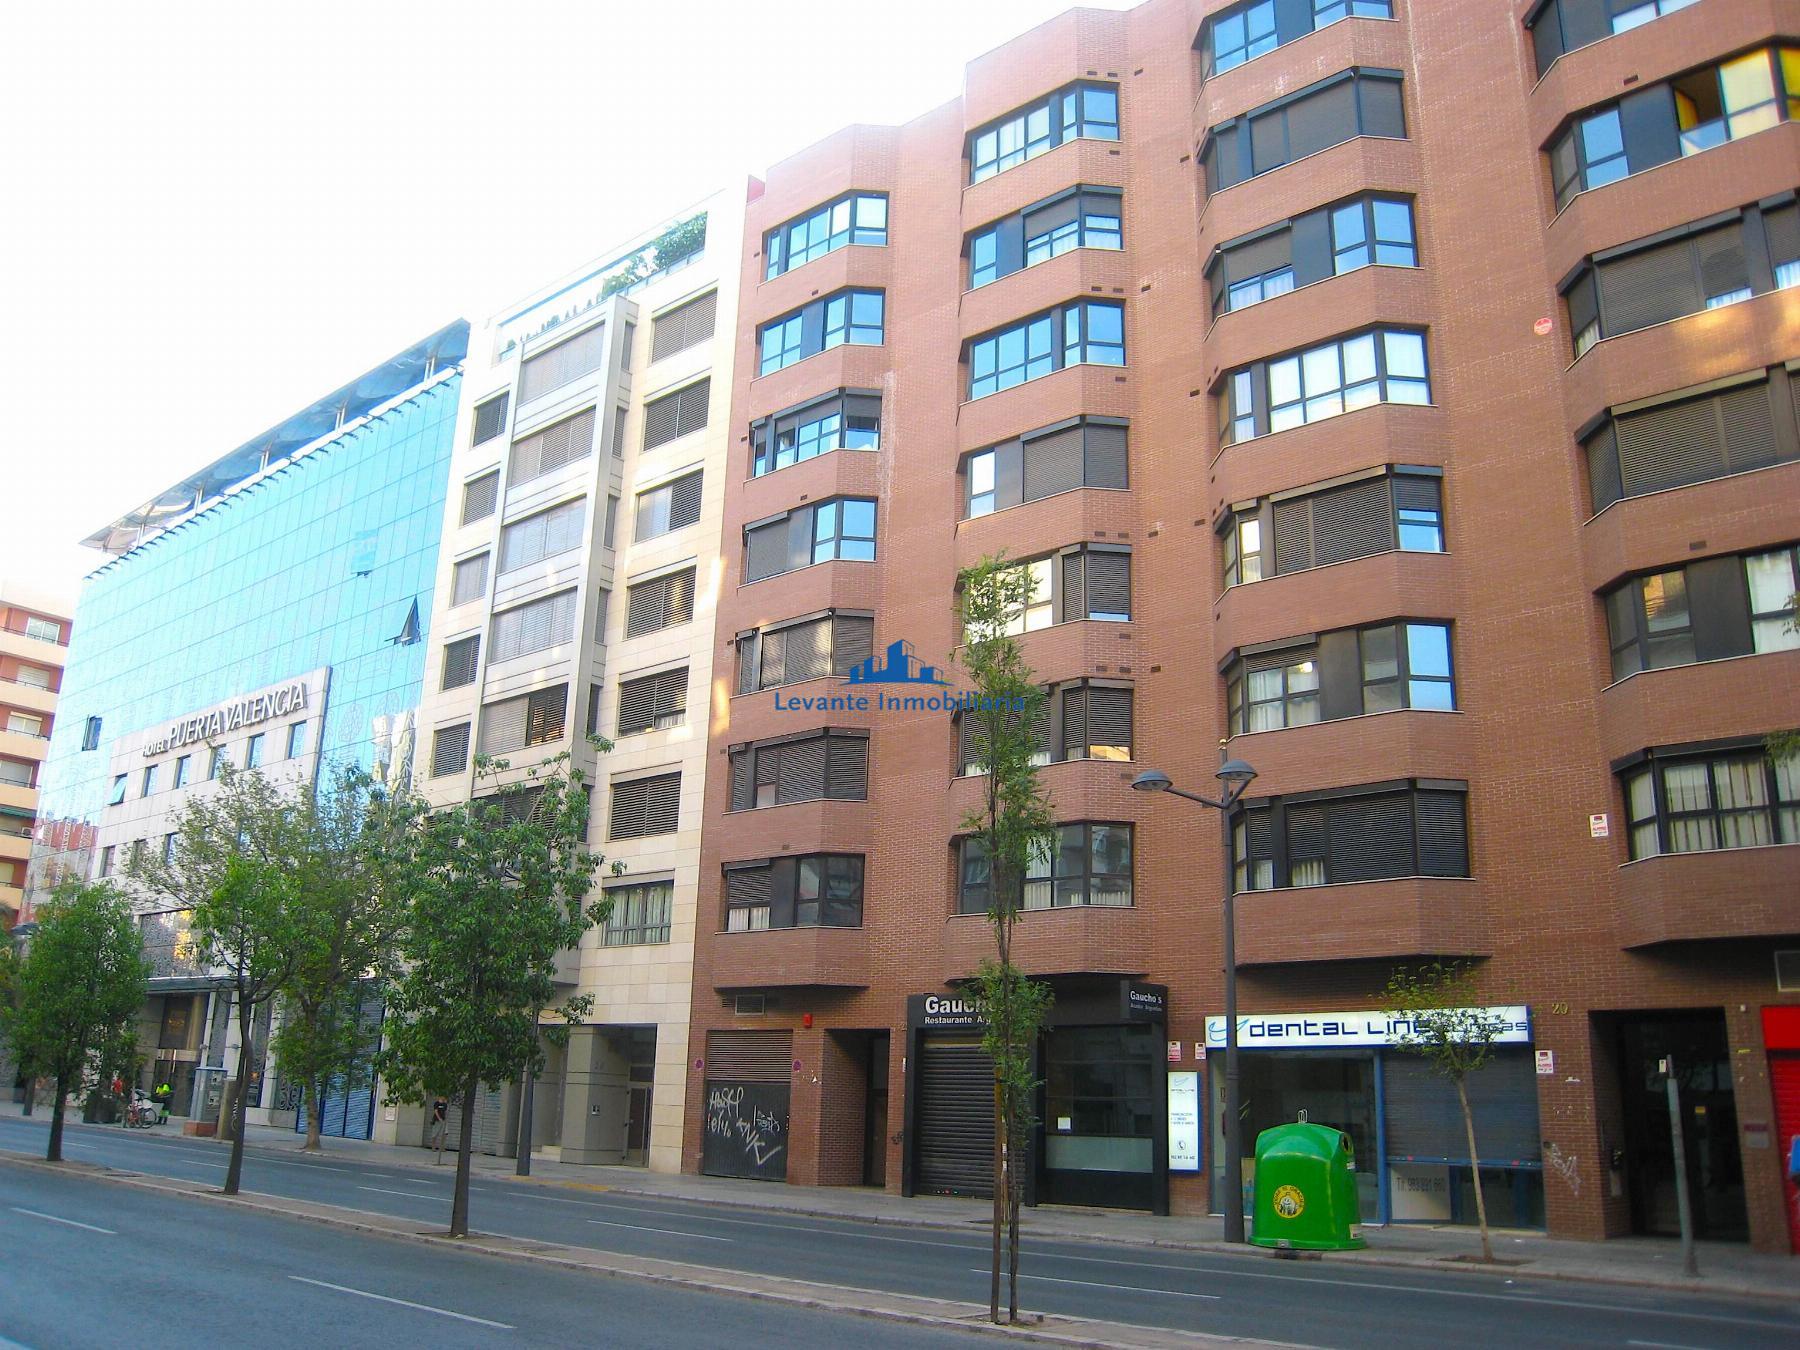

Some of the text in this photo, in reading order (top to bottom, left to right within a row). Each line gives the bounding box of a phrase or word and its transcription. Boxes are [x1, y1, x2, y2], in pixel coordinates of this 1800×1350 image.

[143, 682, 307, 757] HOTEL PUERTA VALENCIA
[924, 1016, 973, 1025] Restaurante
